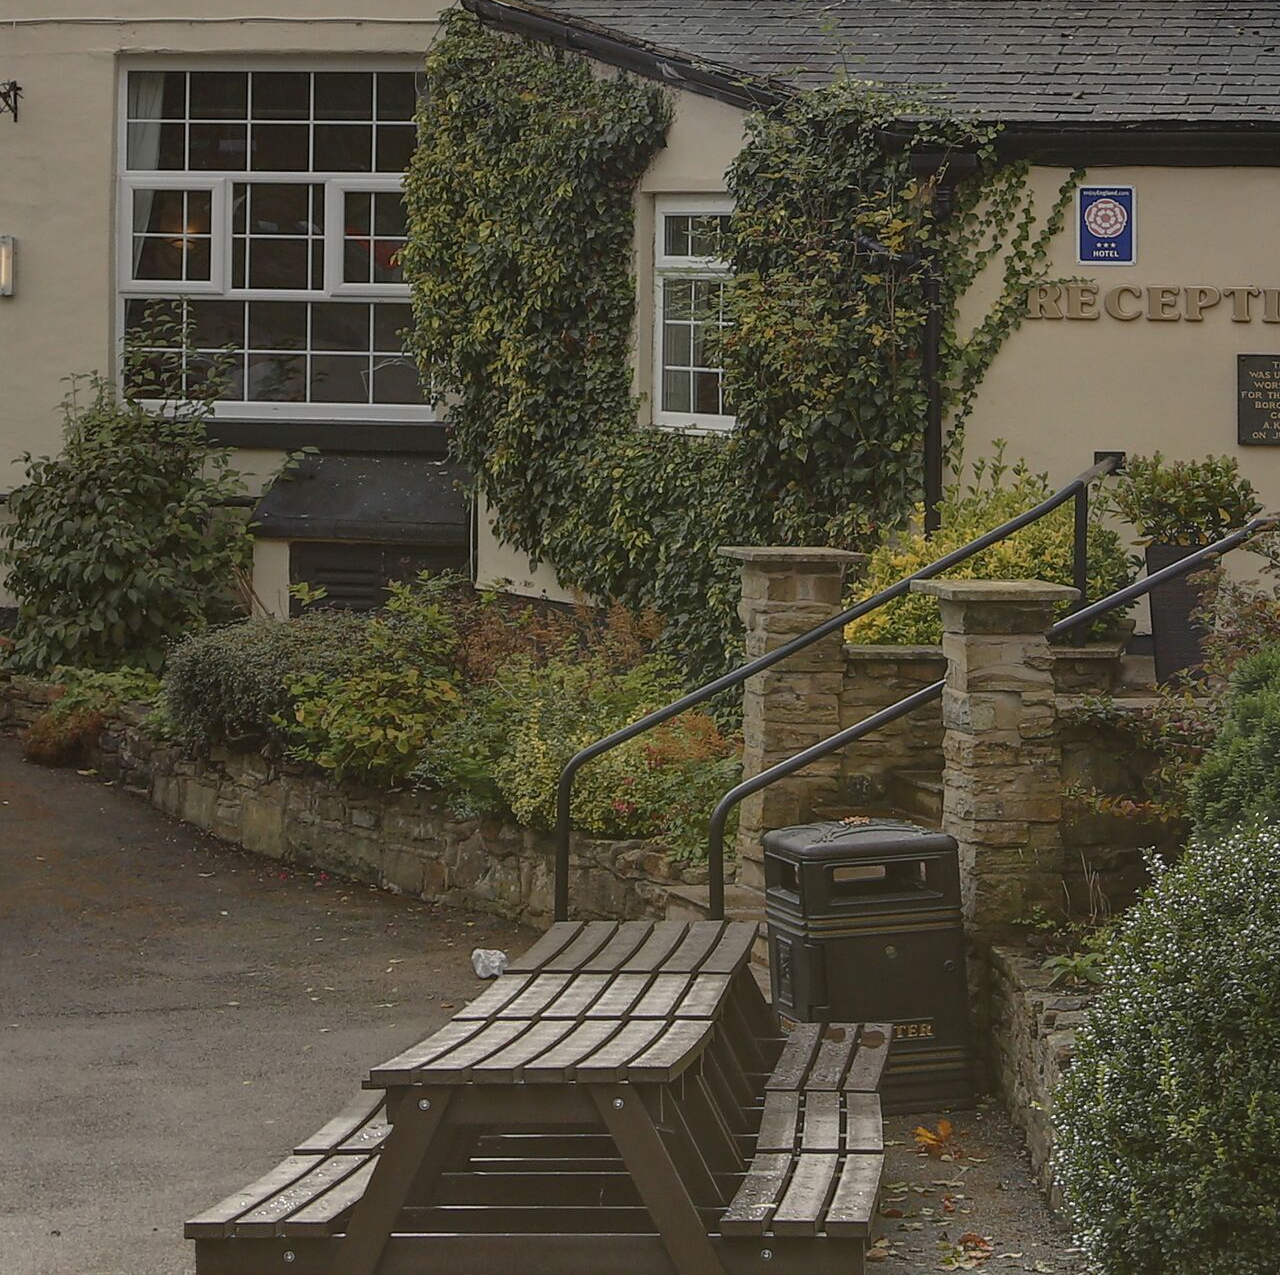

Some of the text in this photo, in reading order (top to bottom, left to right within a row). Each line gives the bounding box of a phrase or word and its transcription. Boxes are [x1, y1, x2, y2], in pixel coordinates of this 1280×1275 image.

[1249, 371, 1271, 379] WAS
[1241, 391, 1263, 399] FOR
[1252, 431, 1266, 439] ON
